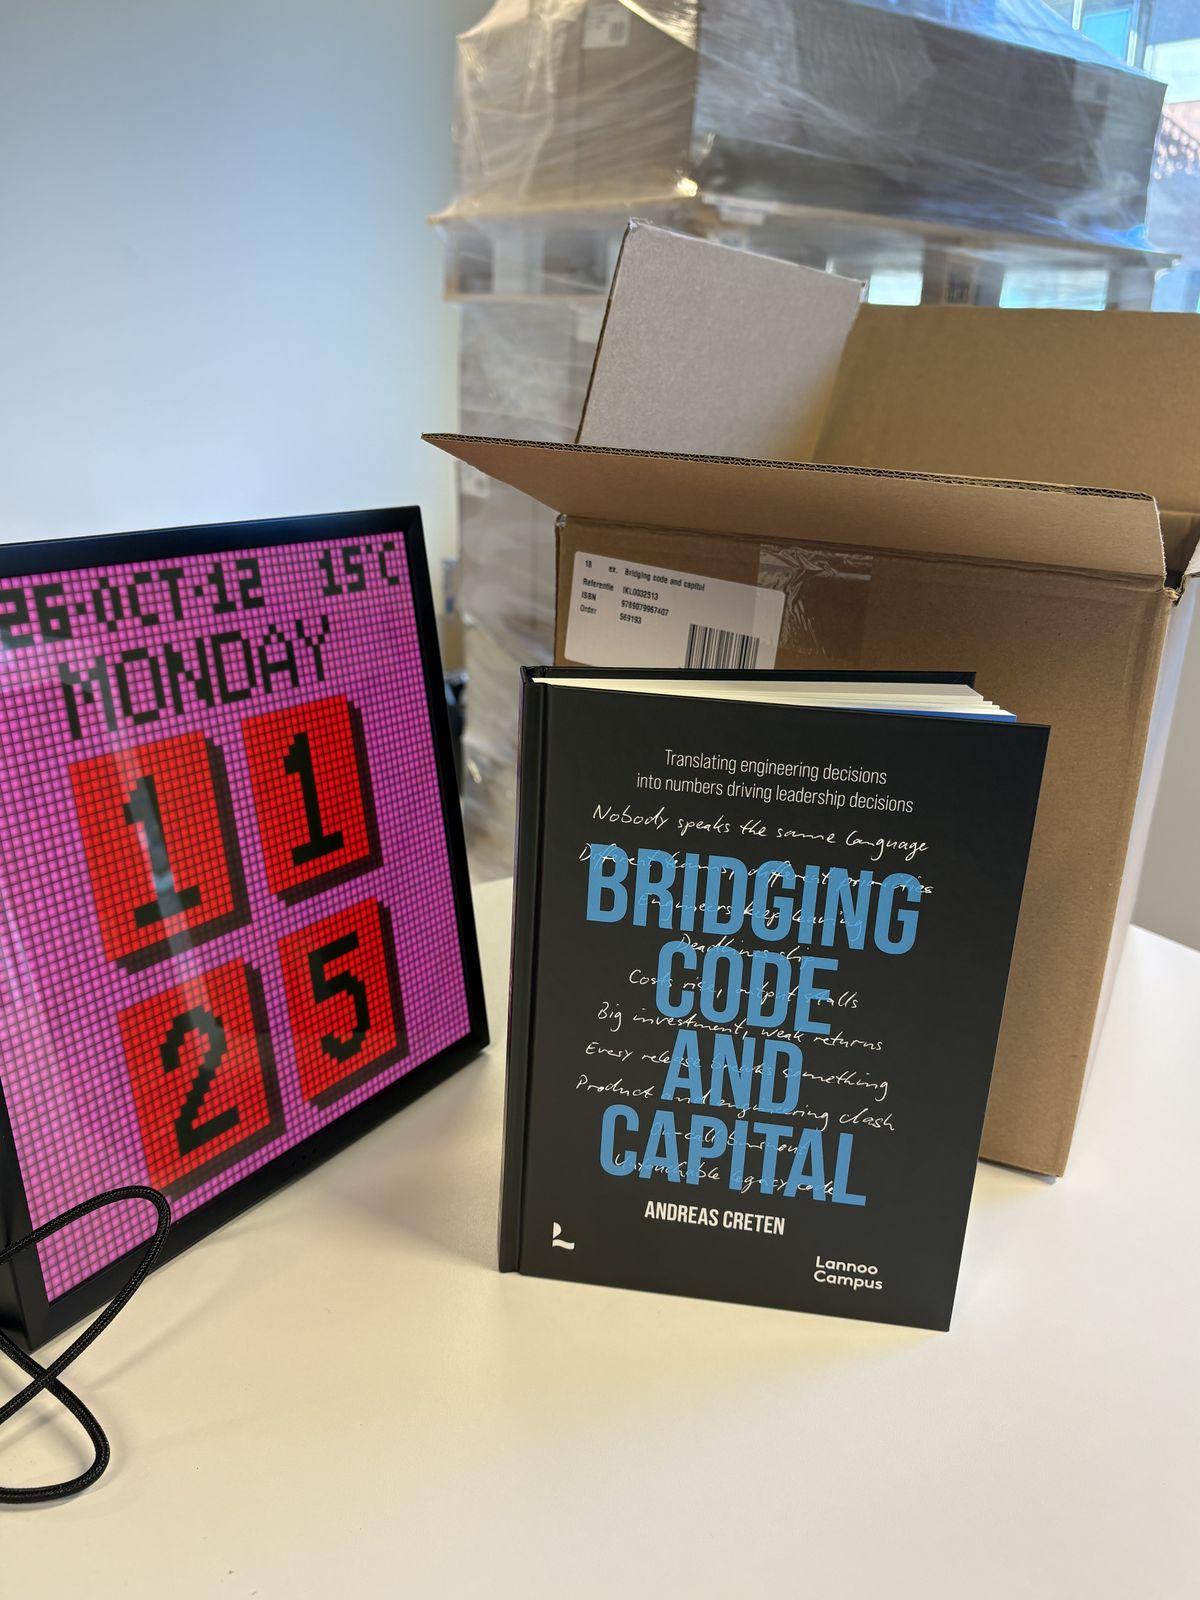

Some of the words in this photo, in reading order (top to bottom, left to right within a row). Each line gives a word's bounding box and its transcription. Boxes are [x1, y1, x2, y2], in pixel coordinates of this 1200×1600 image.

[581, 591, 597, 601] ISBN
[582, 578, 615, 592] Referentie
[624, 568, 651, 582] Bridging
[653, 575, 668, 584] code
[670, 577, 682, 587] and
[683, 581, 705, 592] capital
[579, 604, 598, 615] Order
[58, 614, 331, 740] MONDAY
[665, 748, 737, 774] Translating
[740, 758, 819, 782] engineering
[823, 763, 888, 785] decisions
[636, 772, 662, 791] into
[665, 777, 724, 796] numbers
[727, 782, 772, 803] driving
[775, 784, 846, 810] leadership
[849, 791, 914, 813] decisions
[592, 804, 669, 830] Nobody
[677, 814, 731, 837] speaks
[739, 819, 768, 837] the
[776, 827, 836, 844] same
[845, 830, 929, 862] language
[586, 843, 922, 955] BRIDGING
[628, 969, 673, 988] Costs
[683, 976, 723, 998] rise,
[655, 940, 839, 1035] CODE
[597, 1001, 622, 1033] Big
[632, 1007, 749, 1040] investment,
[761, 1028, 806, 1043] weak
[813, 1031, 884, 1051] returns
[585, 1041, 634, 1062] Every
[641, 1050, 702, 1068] release
[782, 1068, 889, 1102] something
[660, 1029, 803, 1115] AND
[575, 1073, 655, 1099] Product
[661, 1089, 712, 1105] and
[839, 1107, 895, 1131] clash
[600, 1104, 867, 1206] CAPITAL
[644, 1200, 719, 1227] ANDREAS
[722, 1210, 785, 1236] CRETEN
[813, 1270, 883, 1290] Campus
[815, 1255, 878, 1275] Lannoo
